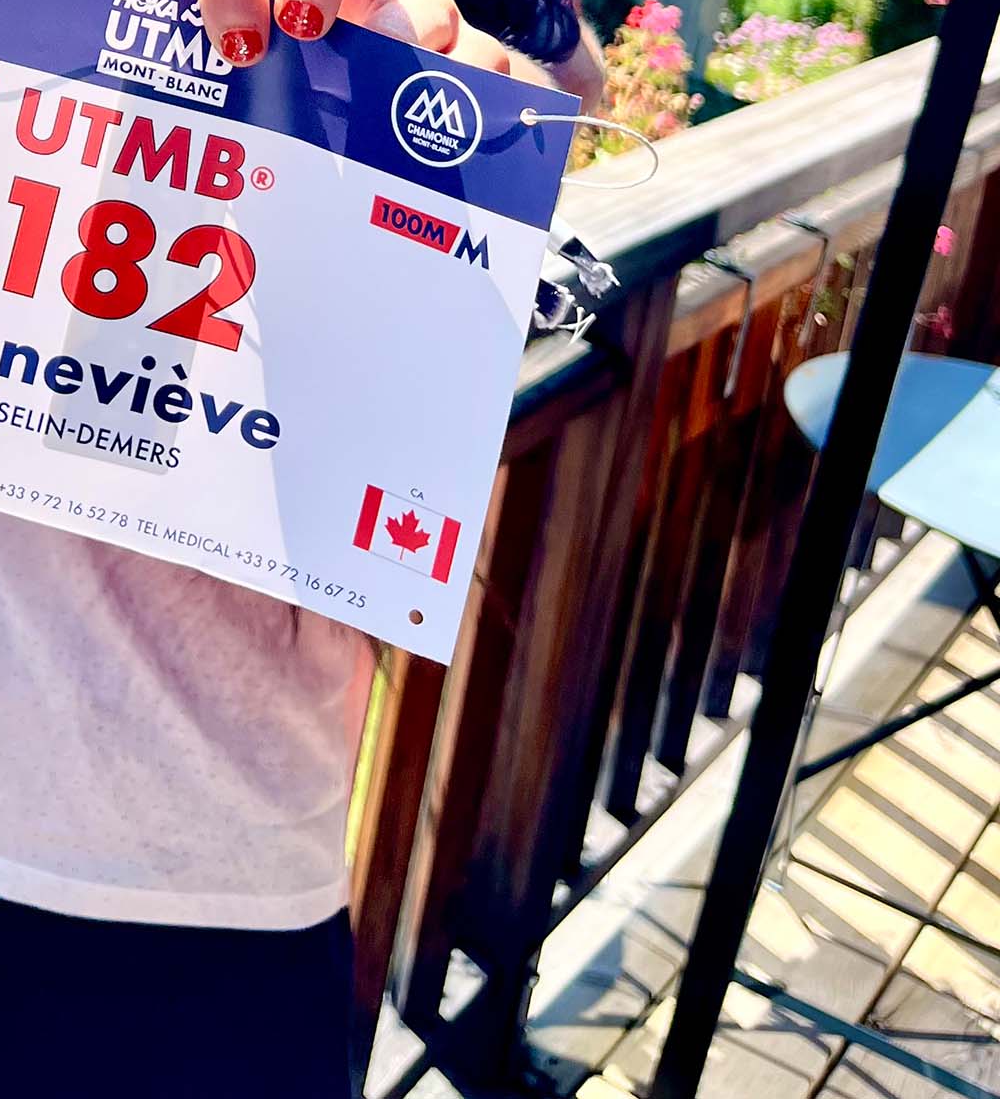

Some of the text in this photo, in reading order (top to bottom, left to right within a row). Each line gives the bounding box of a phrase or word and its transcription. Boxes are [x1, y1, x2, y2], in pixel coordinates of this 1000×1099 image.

[407, 122, 459, 150] CHAMONIX
[2, 176, 257, 352] 182
[410, 488, 424, 500] CA
[30, 491, 40, 502] 9
[42, 494, 62, 510] 72
[68, 500, 83, 516] 16
[87, 505, 106, 522] 52
[109, 511, 129, 528] 78
[136, 519, 158, 537] TEL
[163, 528, 230, 558] MEDICAL
[234, 551, 262, 568] +33
[267, 560, 277, 572] 9
[279, 564, 299, 582] 72
[304, 574, 320, 591] 16
[324, 583, 344, 597] 67
[347, 591, 367, 608] 25
